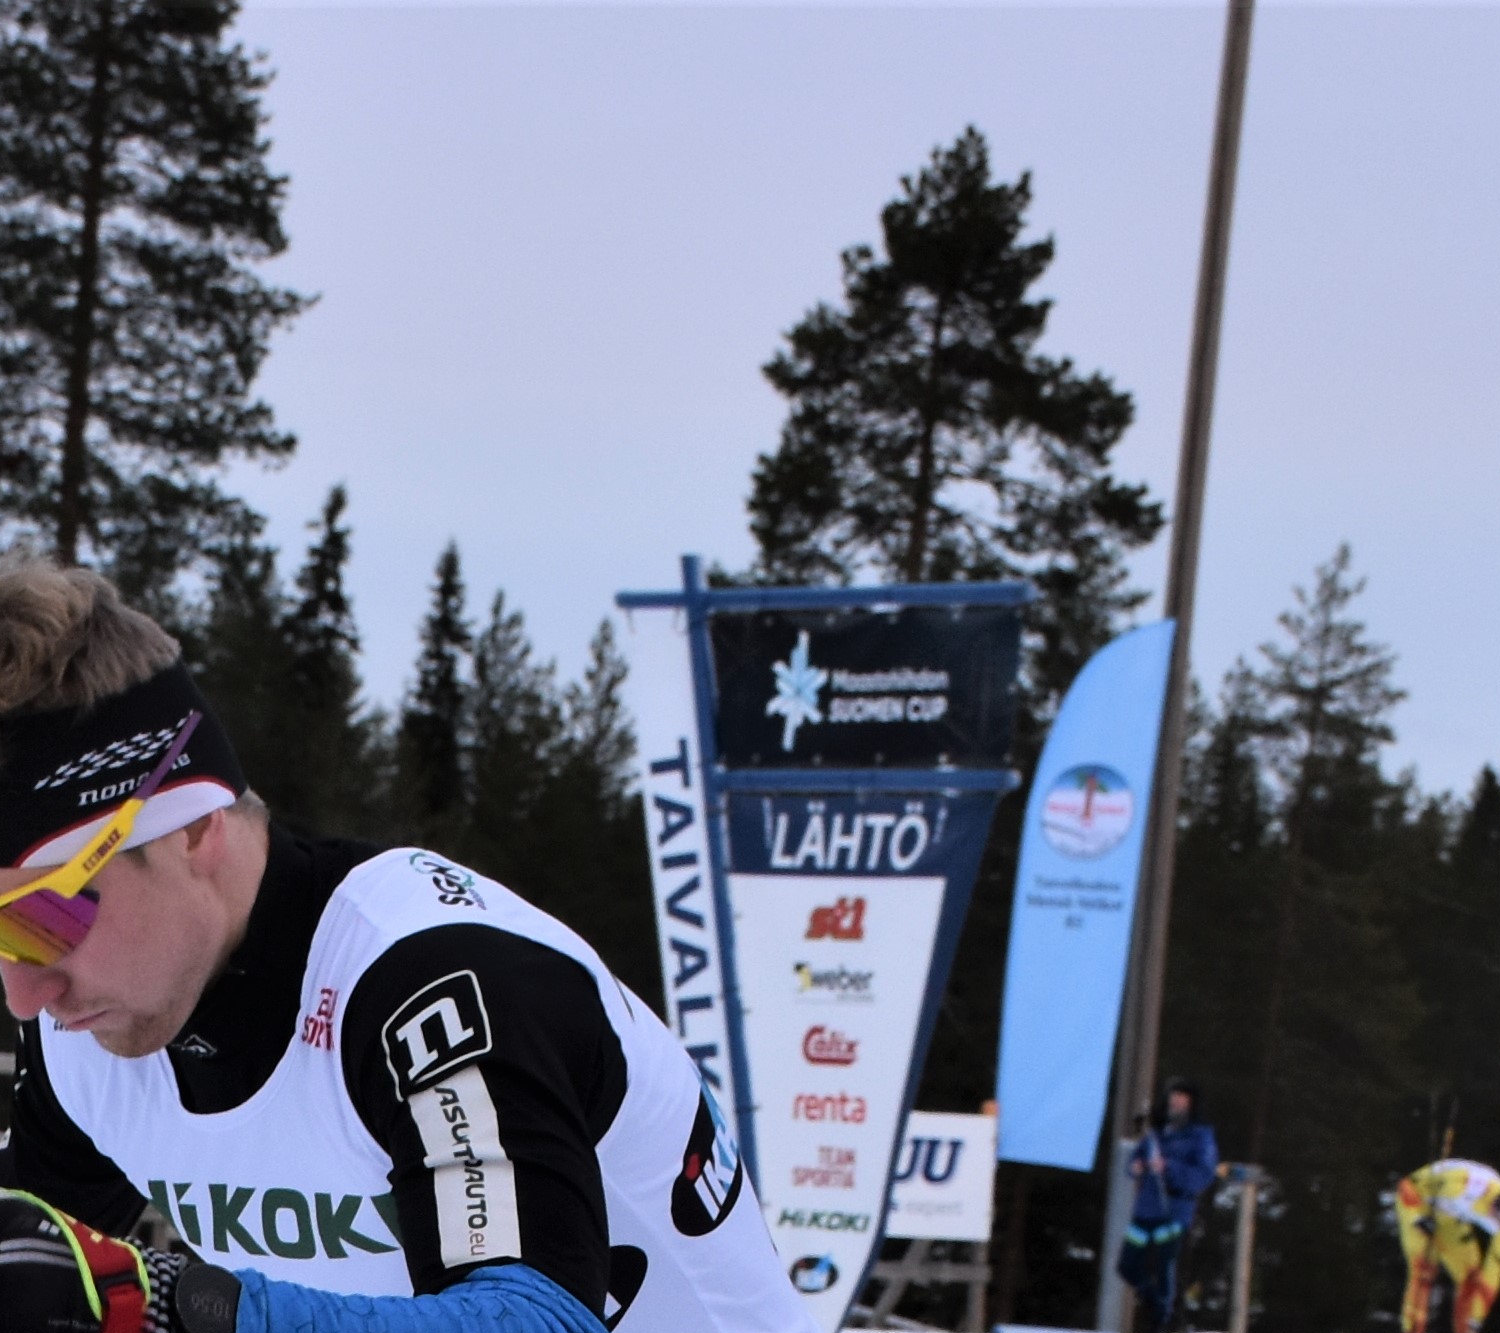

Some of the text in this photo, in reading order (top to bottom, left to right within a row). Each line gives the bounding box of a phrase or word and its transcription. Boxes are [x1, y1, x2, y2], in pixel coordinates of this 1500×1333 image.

[906, 695, 949, 721] CUP
[770, 801, 930, 871] LÄHTÖ
[803, 1024, 858, 1067] Calix
[793, 1090, 868, 1124] renta
